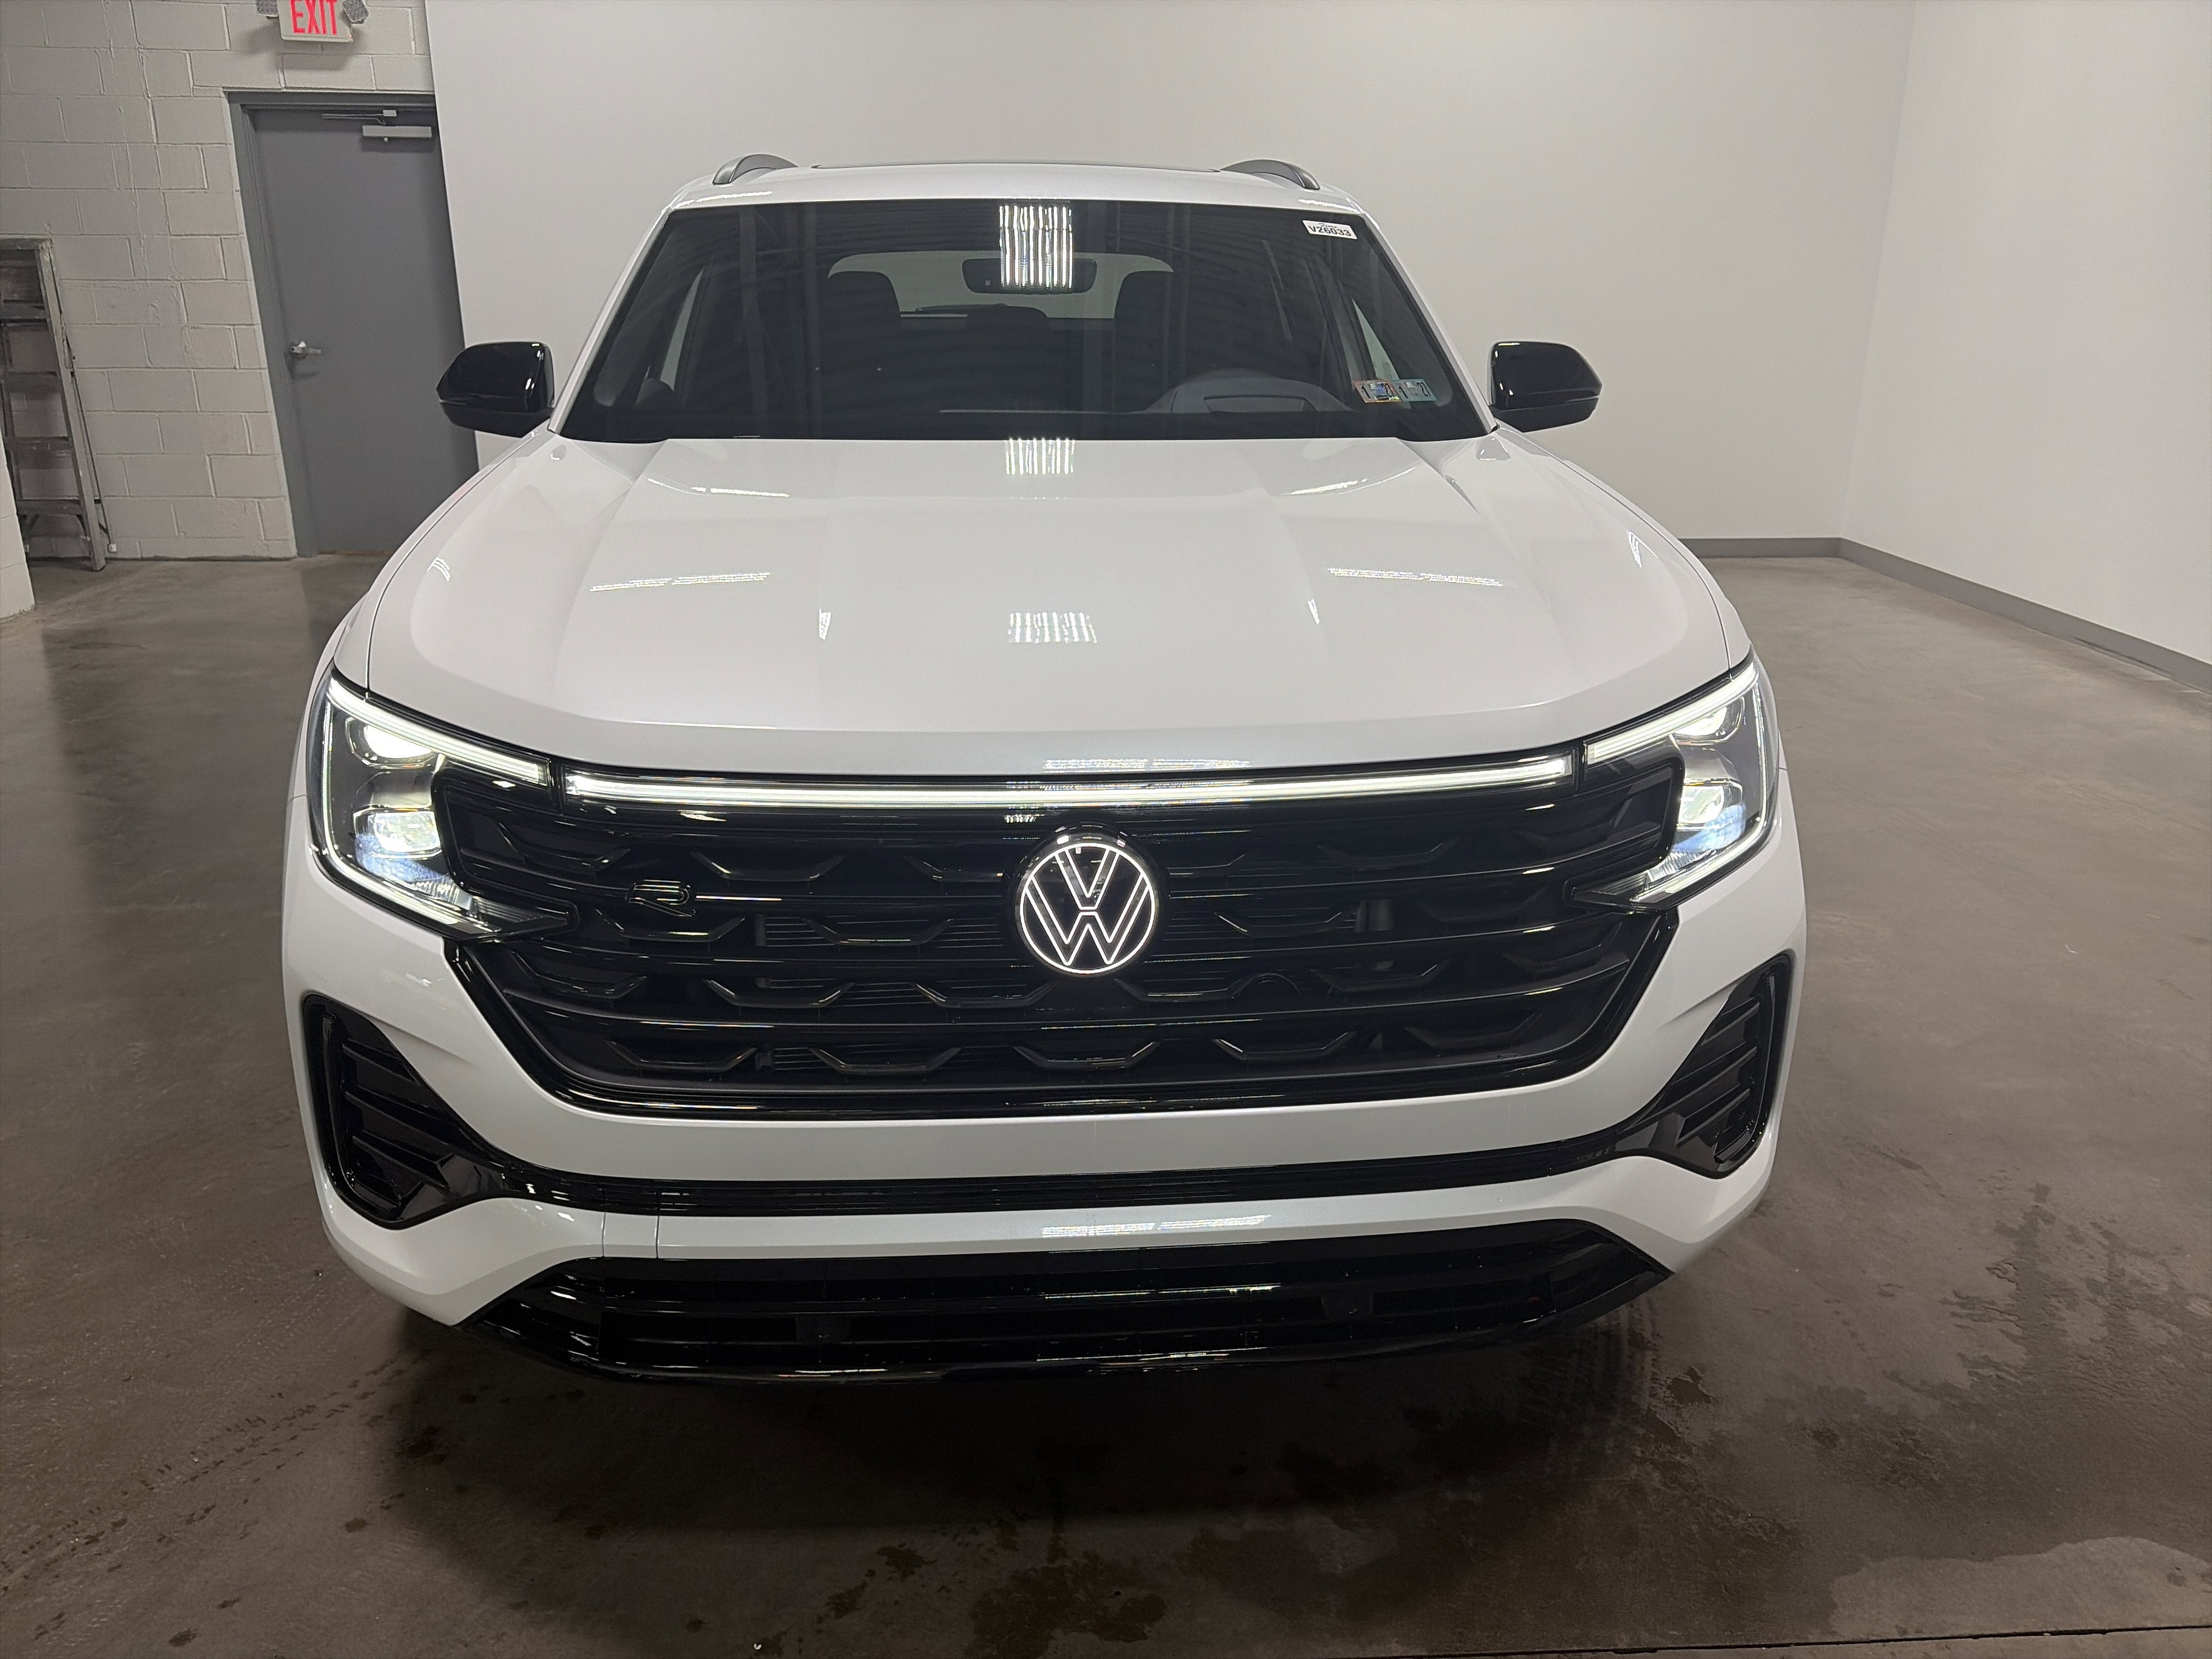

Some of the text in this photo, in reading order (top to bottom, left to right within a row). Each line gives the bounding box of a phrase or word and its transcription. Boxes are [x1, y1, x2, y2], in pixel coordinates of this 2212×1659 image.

[289, 0, 337, 35] EXIT
[1308, 225, 1352, 236] V26033
[1021, 844, 1153, 972] VW
